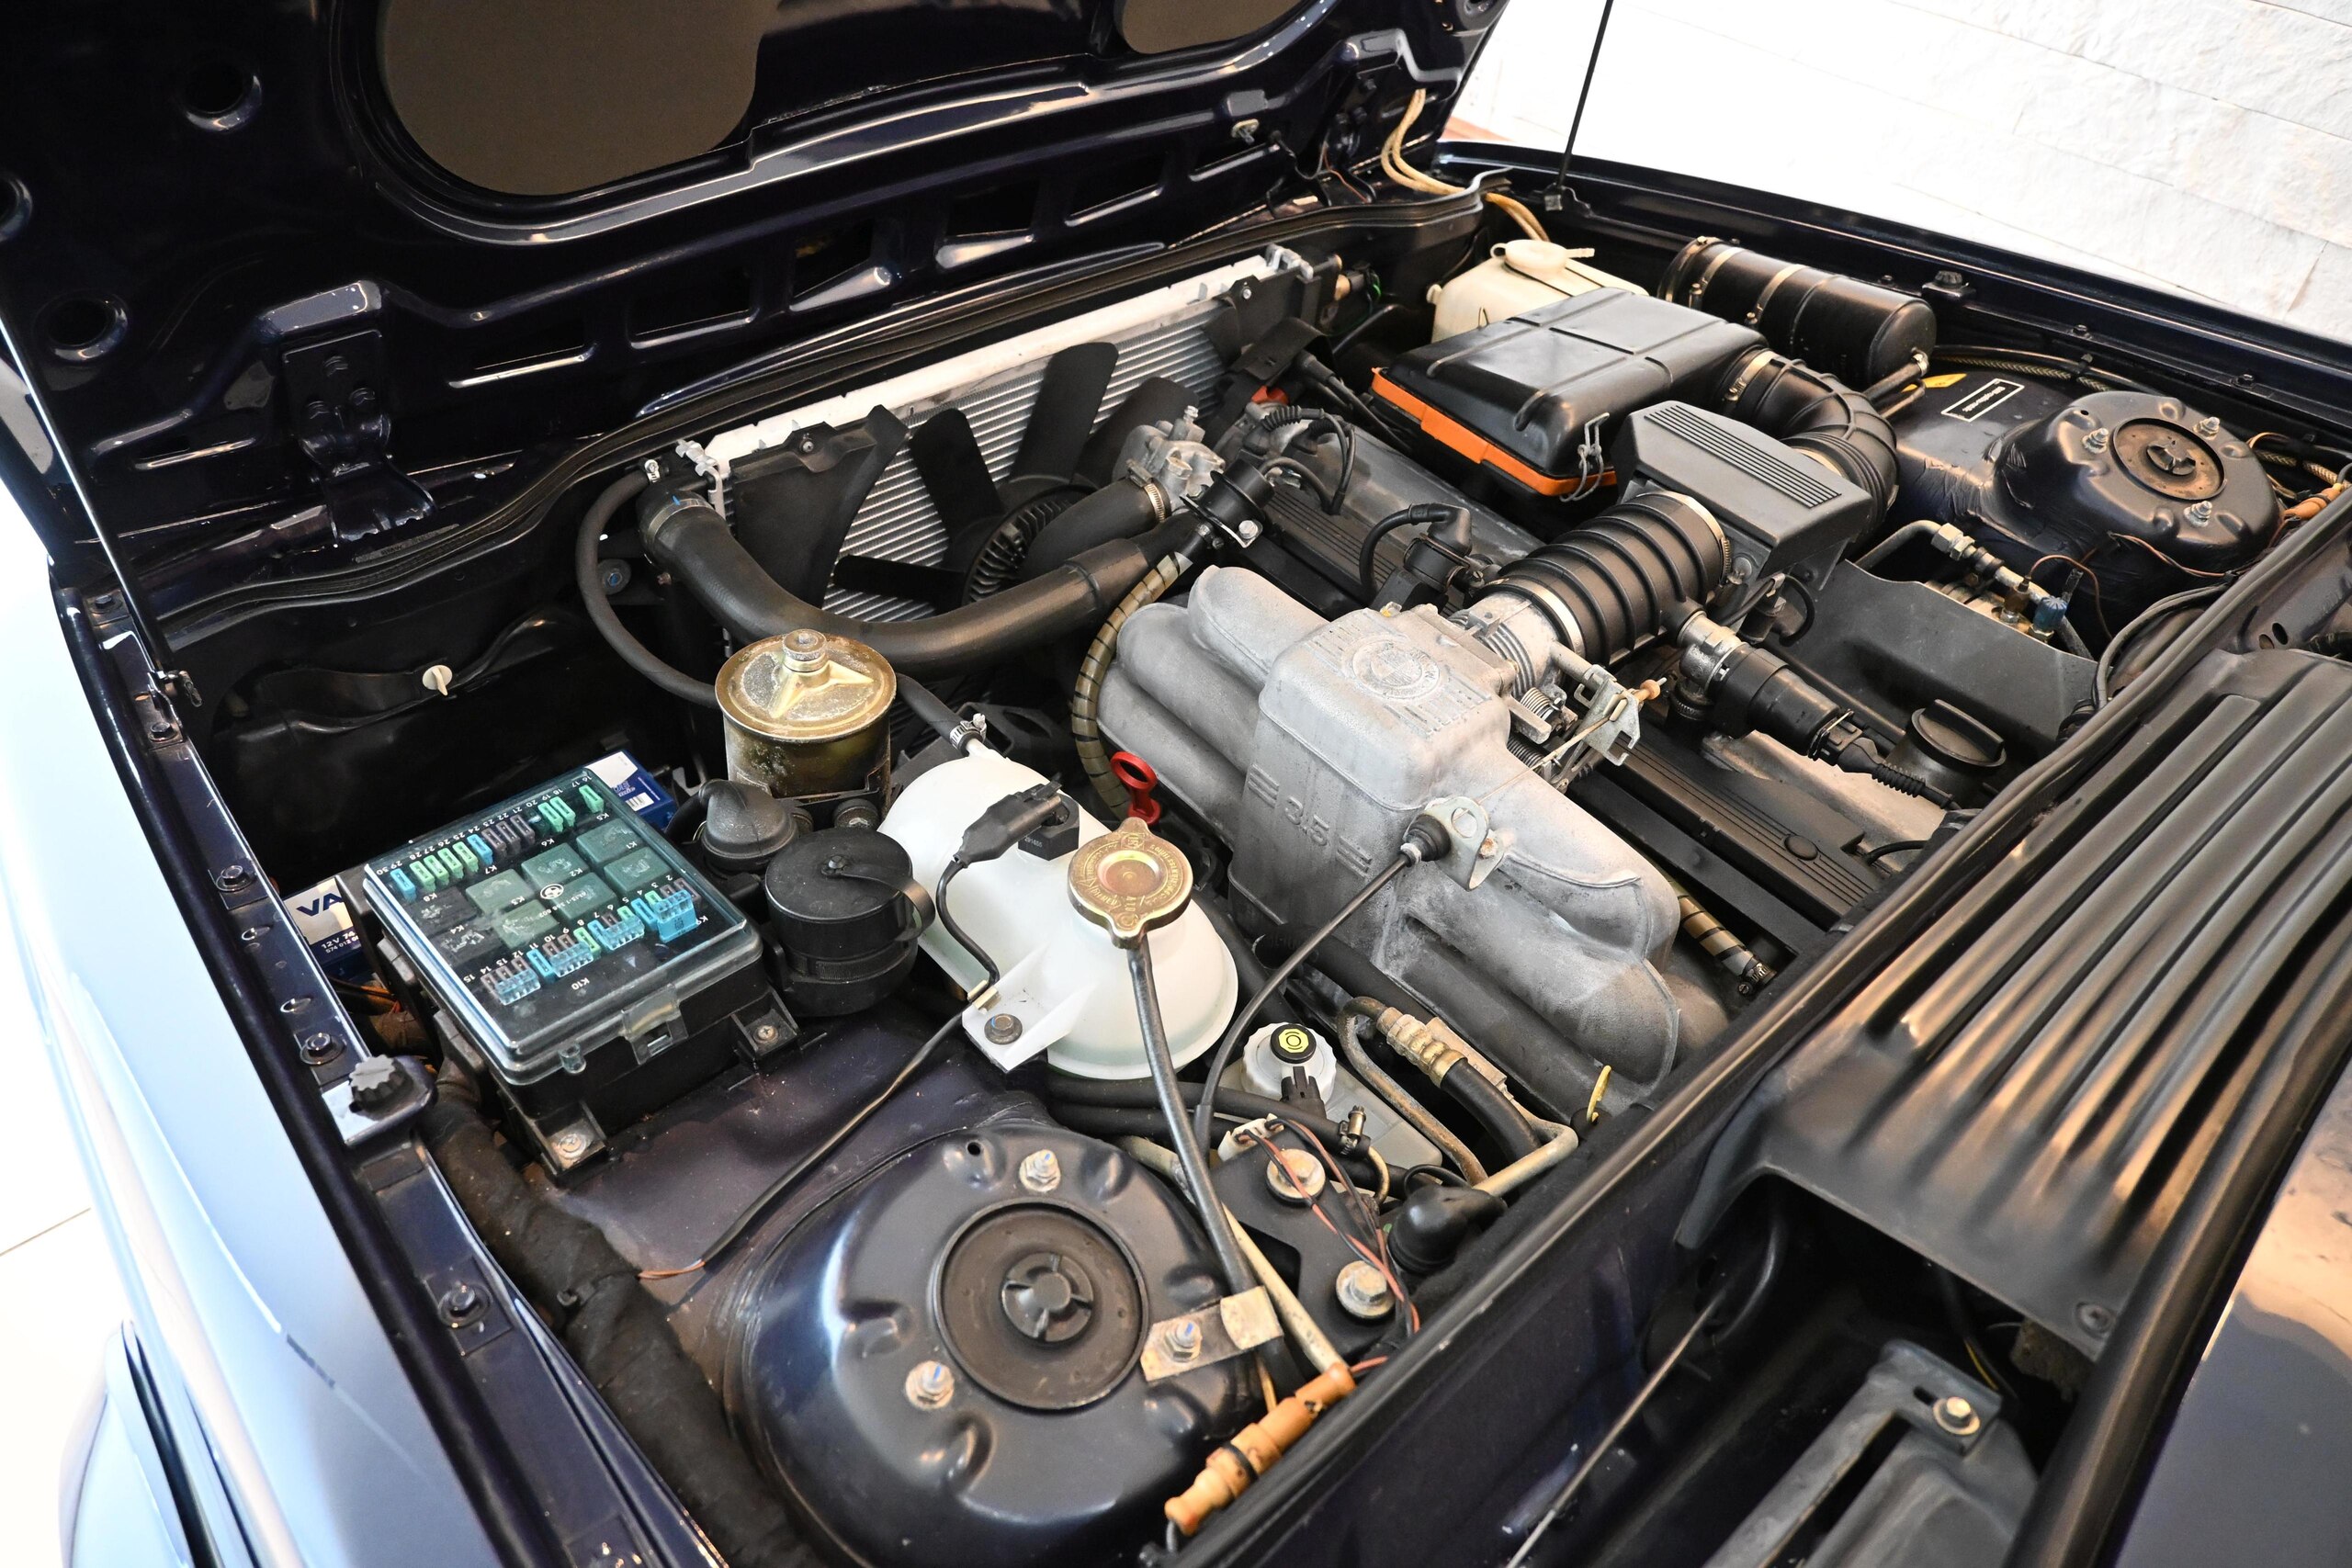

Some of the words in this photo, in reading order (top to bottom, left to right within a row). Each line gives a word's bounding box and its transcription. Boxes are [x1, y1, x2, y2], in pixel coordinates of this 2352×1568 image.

[498, 813, 509, 821] 22
[596, 813, 610, 821] K5
[468, 826, 481, 834] 24
[453, 832, 466, 841] 25
[541, 838, 555, 847] K6
[626, 841, 638, 850] K1
[409, 852, 422, 860] 28
[390, 860, 402, 870] 29
[485, 865, 498, 874] K7
[376, 866, 389, 875] 30
[570, 867, 583, 877] K2
[424, 892, 438, 902] K8
[512, 897, 526, 905] K3
[696, 915, 708, 925] K9
[450, 925, 465, 934] K4
[544, 934, 556, 942] 10
[339, 940, 351, 948] 012
[481, 966, 492, 975] 14
[464, 974, 476, 983] 15
[571, 977, 590, 990] K10
